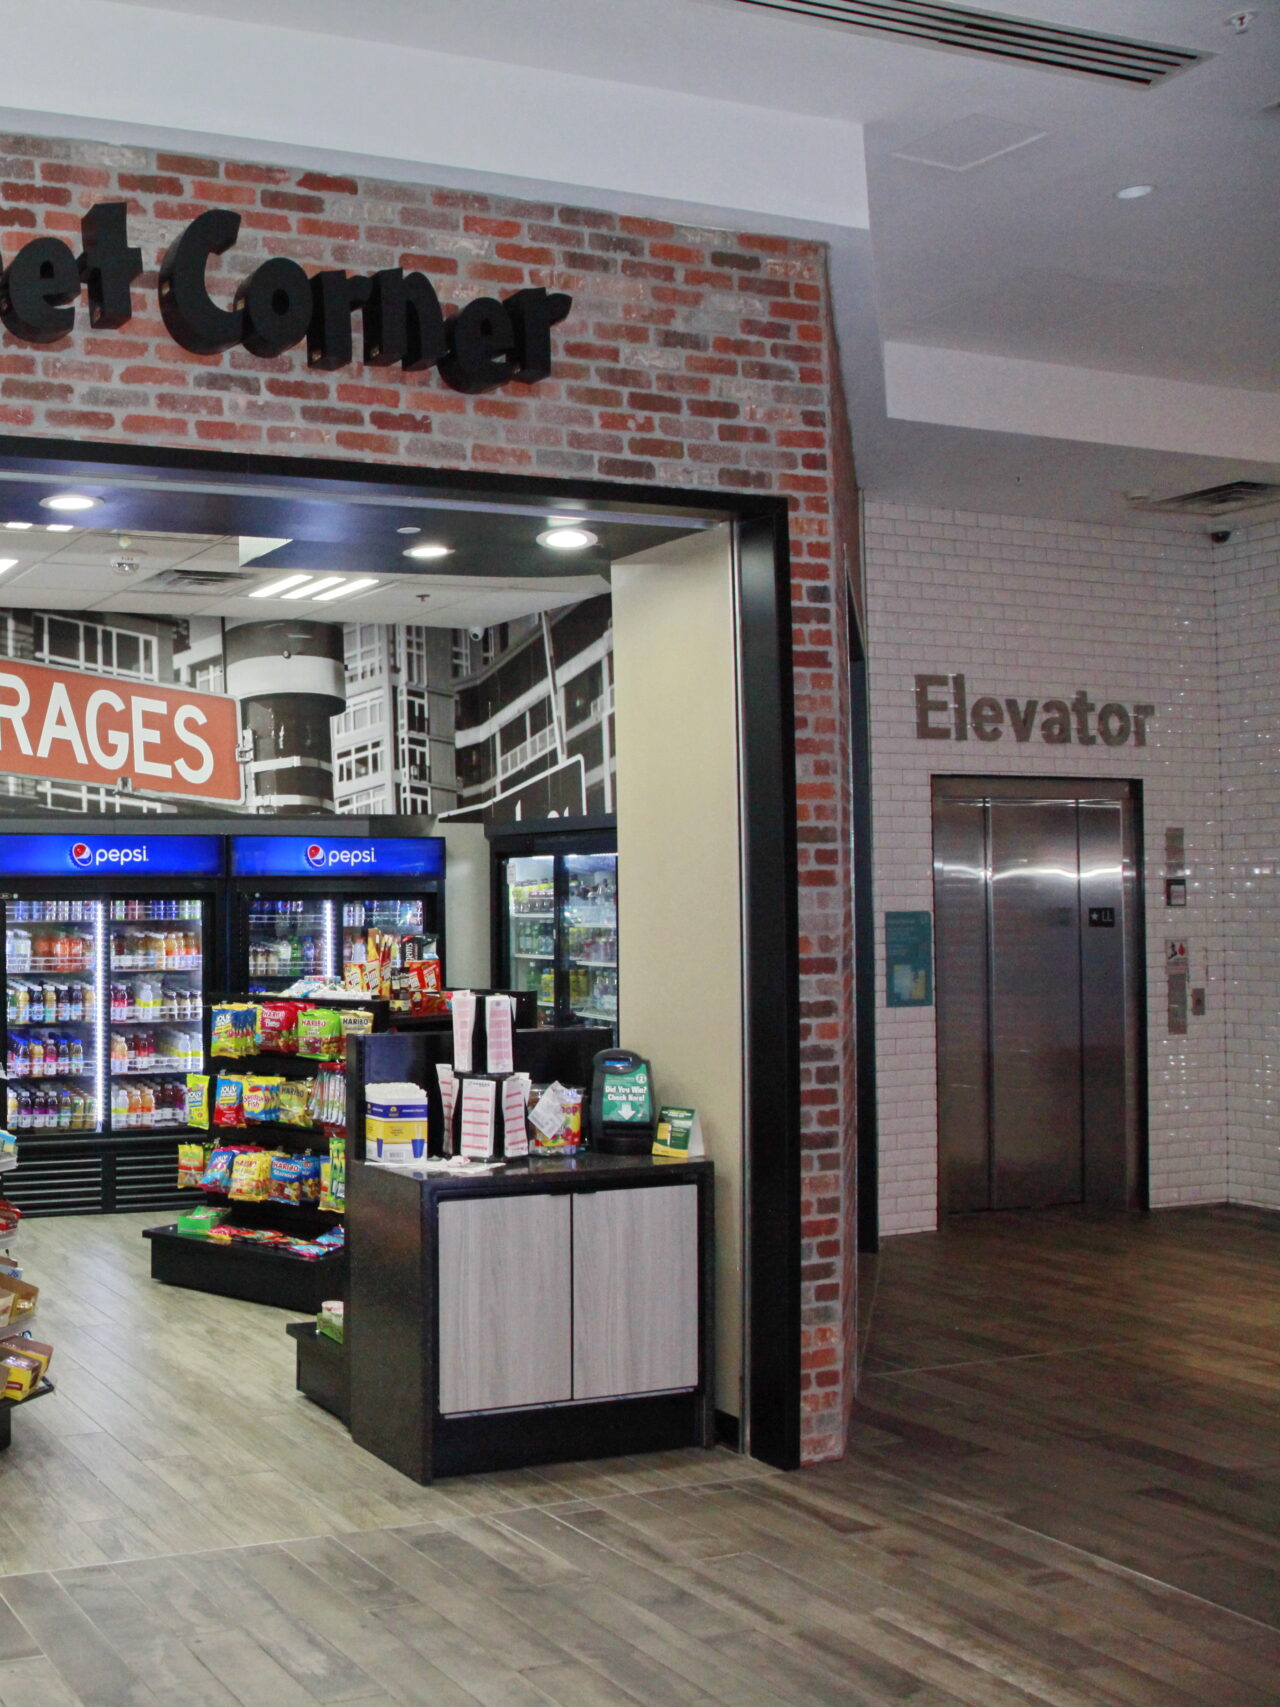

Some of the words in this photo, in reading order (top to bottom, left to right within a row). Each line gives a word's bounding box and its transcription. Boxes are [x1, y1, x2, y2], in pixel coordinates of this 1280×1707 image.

[159, 209, 572, 394] Corner
[914, 673, 1155, 746] Elevator
[96, 846, 147, 865] pepsi
[329, 848, 374, 866] pepsi
[343, 1018, 368, 1026] HARIBO
